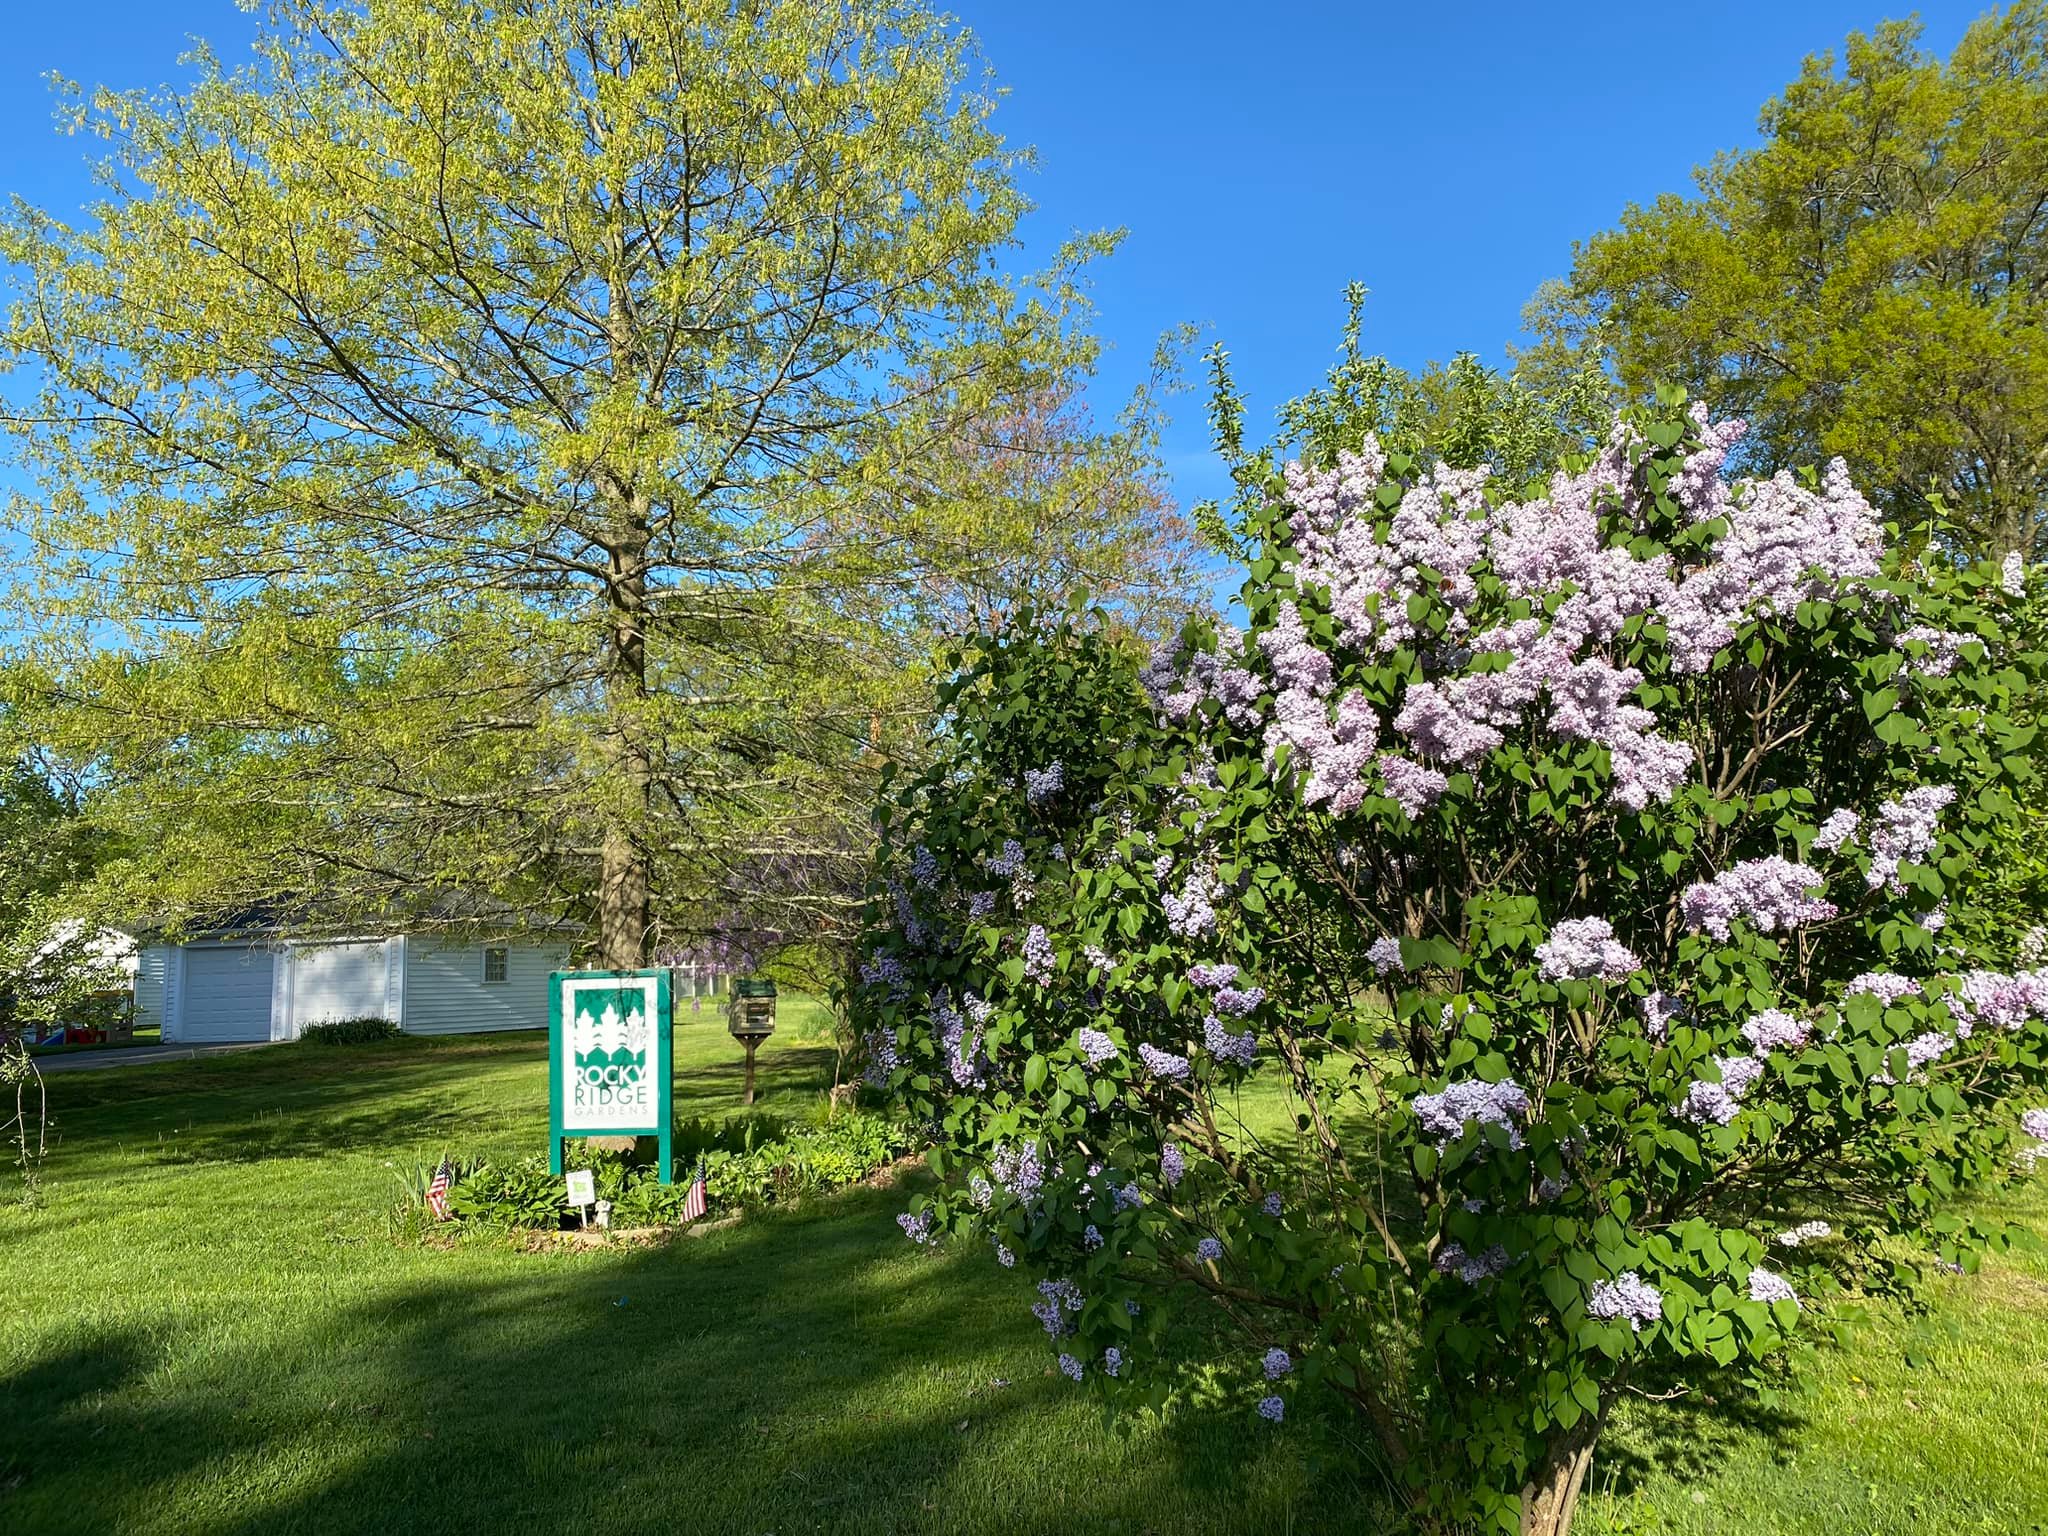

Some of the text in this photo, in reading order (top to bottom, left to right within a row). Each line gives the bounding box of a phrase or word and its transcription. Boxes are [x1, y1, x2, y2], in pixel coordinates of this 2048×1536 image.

[575, 1065, 647, 1086] ROCKY
[575, 1086, 648, 1106] RIDGE
[574, 1105, 648, 1116] GARDENS
